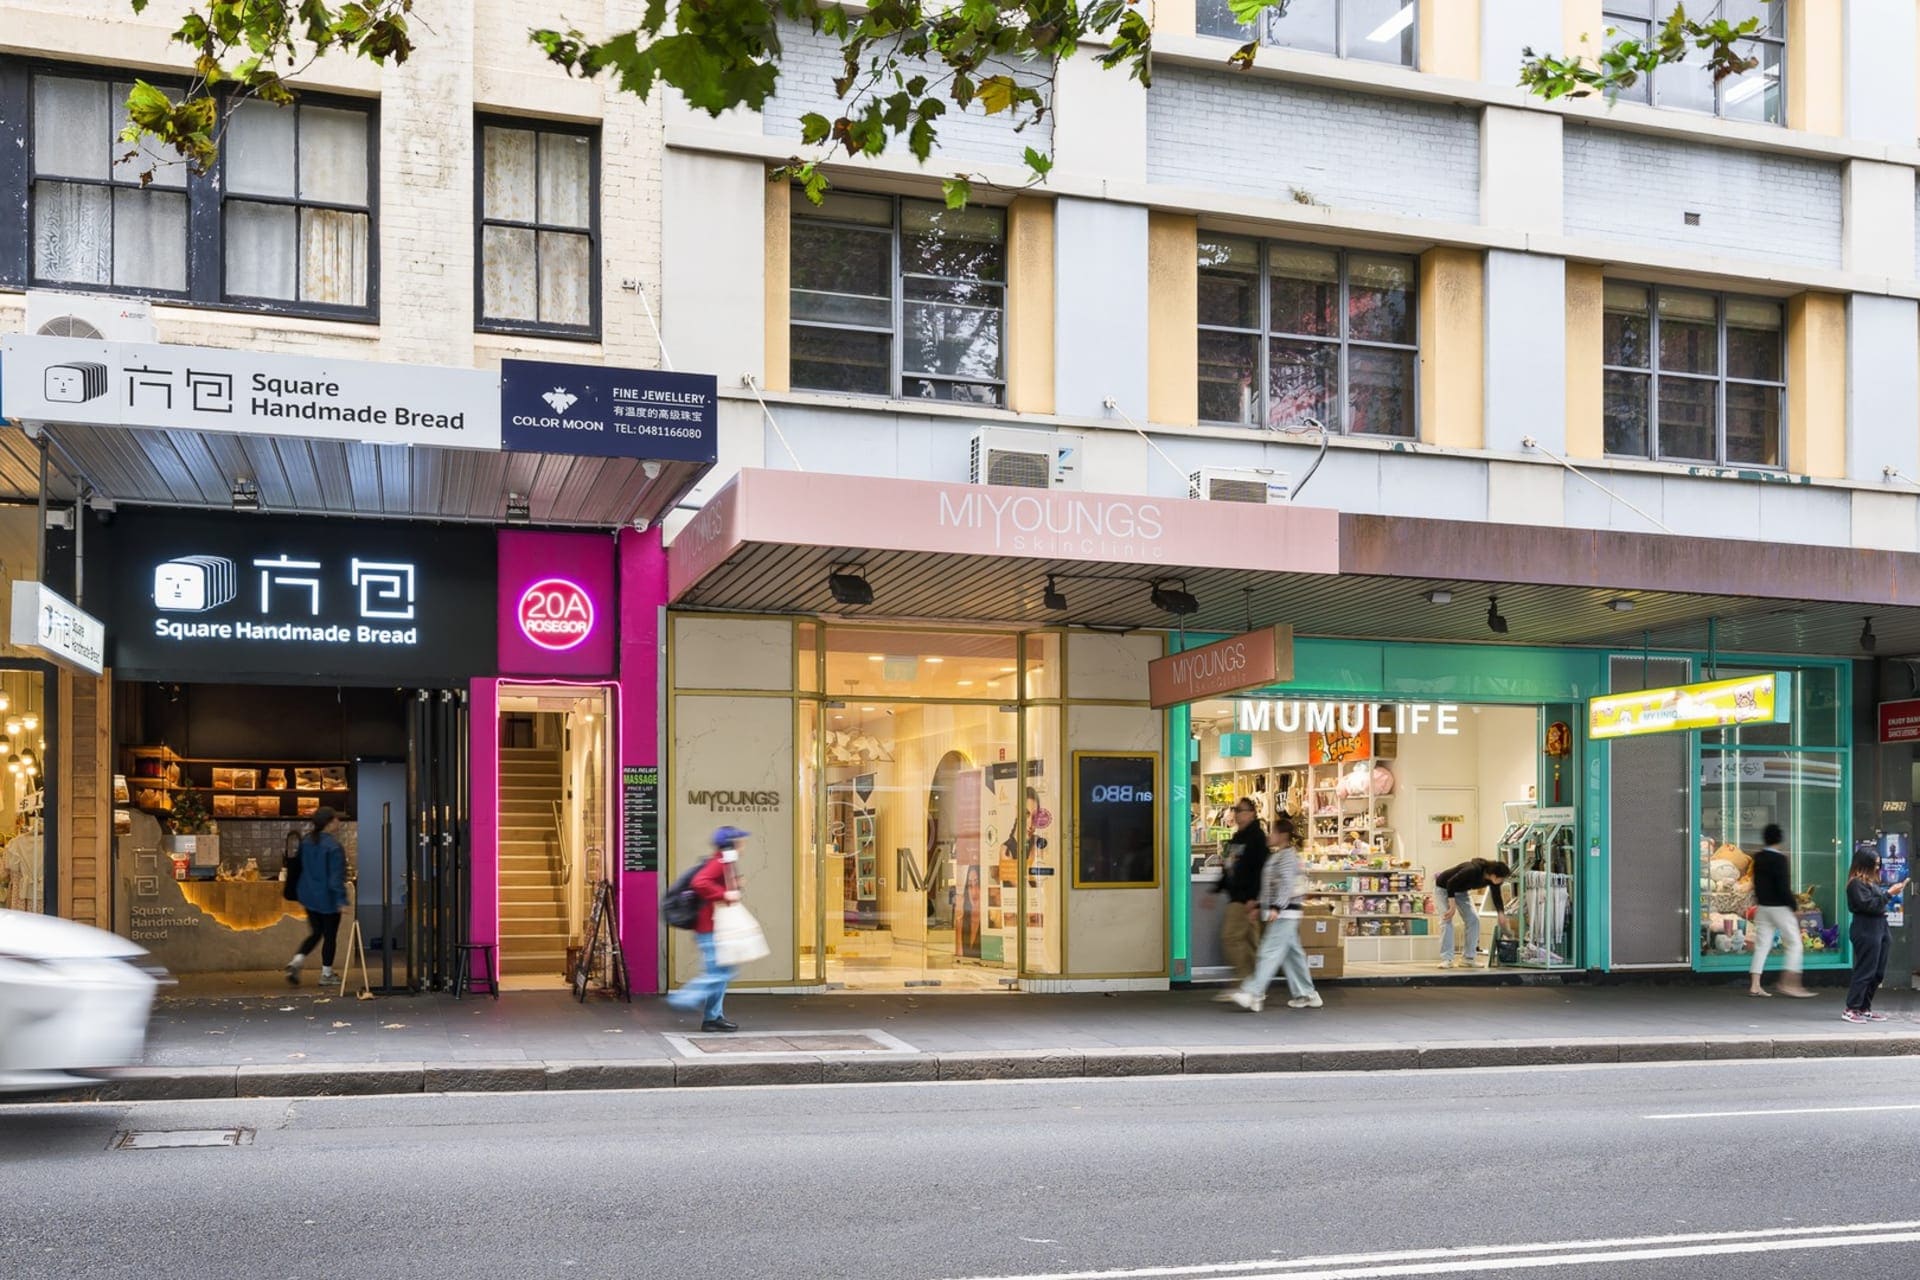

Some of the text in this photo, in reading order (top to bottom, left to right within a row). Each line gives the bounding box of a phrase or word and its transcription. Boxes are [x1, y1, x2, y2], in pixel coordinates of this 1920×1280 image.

[251, 373, 339, 397] Square
[613, 387, 705, 404] FINE JEWELLERY
[251, 398, 464, 430] Handmade Bread
[512, 416, 604, 431] COLOR MOON
[614, 423, 702, 439] TEL: 0481166080
[939, 491, 1163, 548] MIYOUNGS
[527, 591, 588, 620] 20A
[155, 618, 417, 644] Square Handmade Bread
[1172, 643, 1246, 694] MIYOUNGS
[1239, 699, 1459, 735] MUMULIFE
[624, 774, 657, 785] MASSAGE
[687, 790, 780, 812] MIYOUNGS
[131, 906, 175, 916] Square
[131, 916, 199, 927] Handmade
[131, 930, 168, 940] Bread
